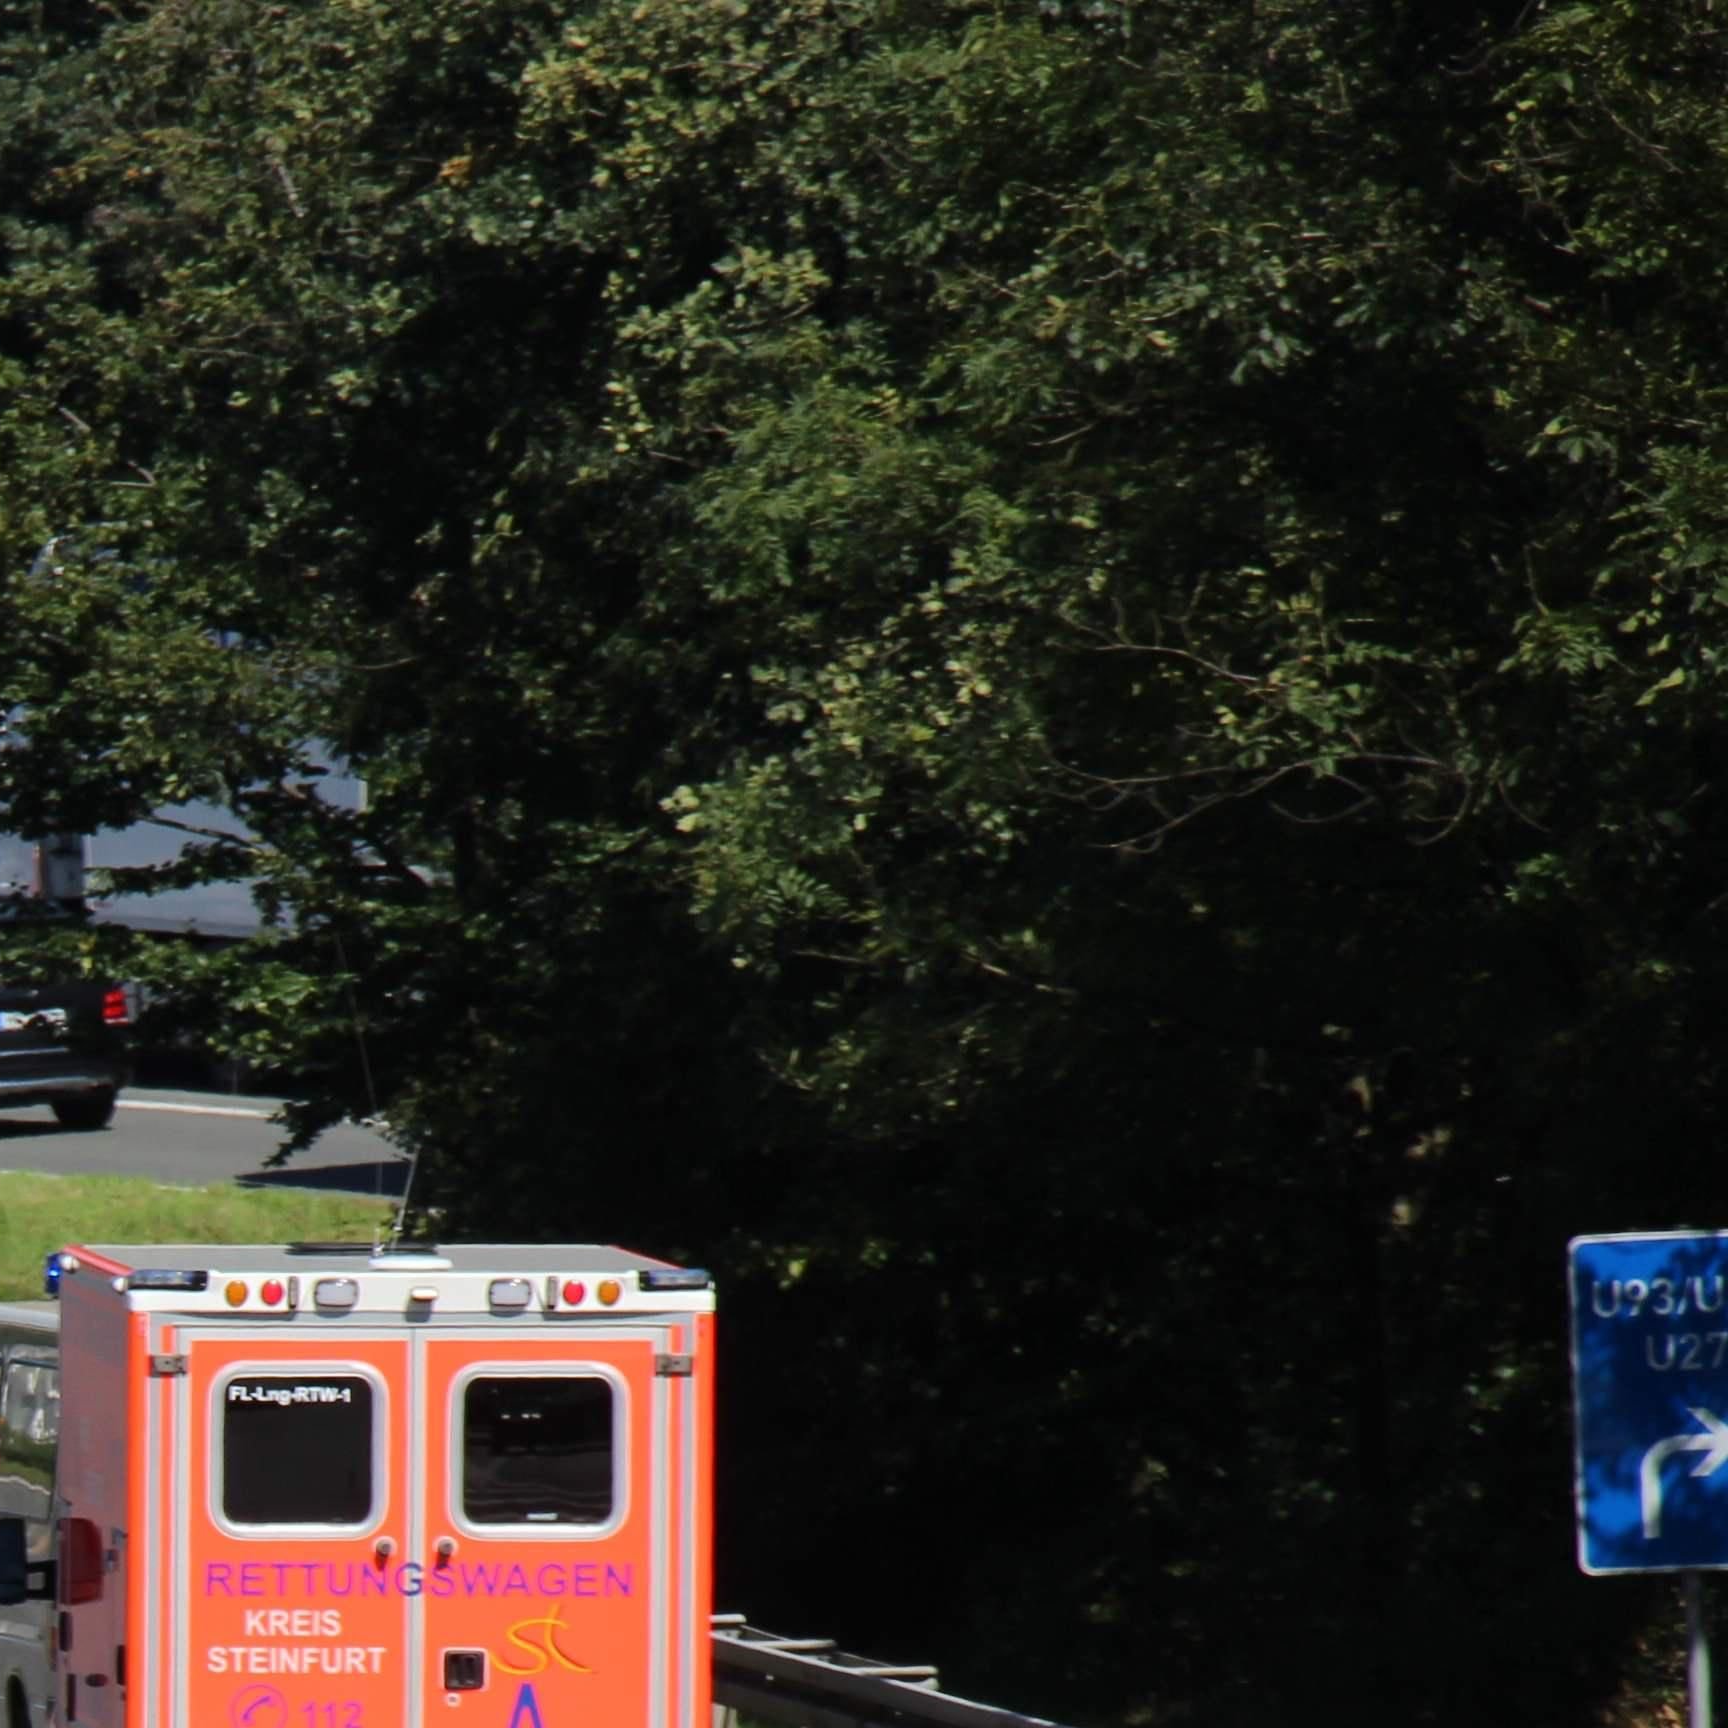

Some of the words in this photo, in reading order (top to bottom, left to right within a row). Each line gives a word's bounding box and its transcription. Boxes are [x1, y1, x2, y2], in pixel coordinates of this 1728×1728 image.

[206, 1562, 633, 1598] RETTUNGSWAGEN
[244, 1609, 342, 1637] KREIS
[207, 1646, 388, 1675] STEINFURT
